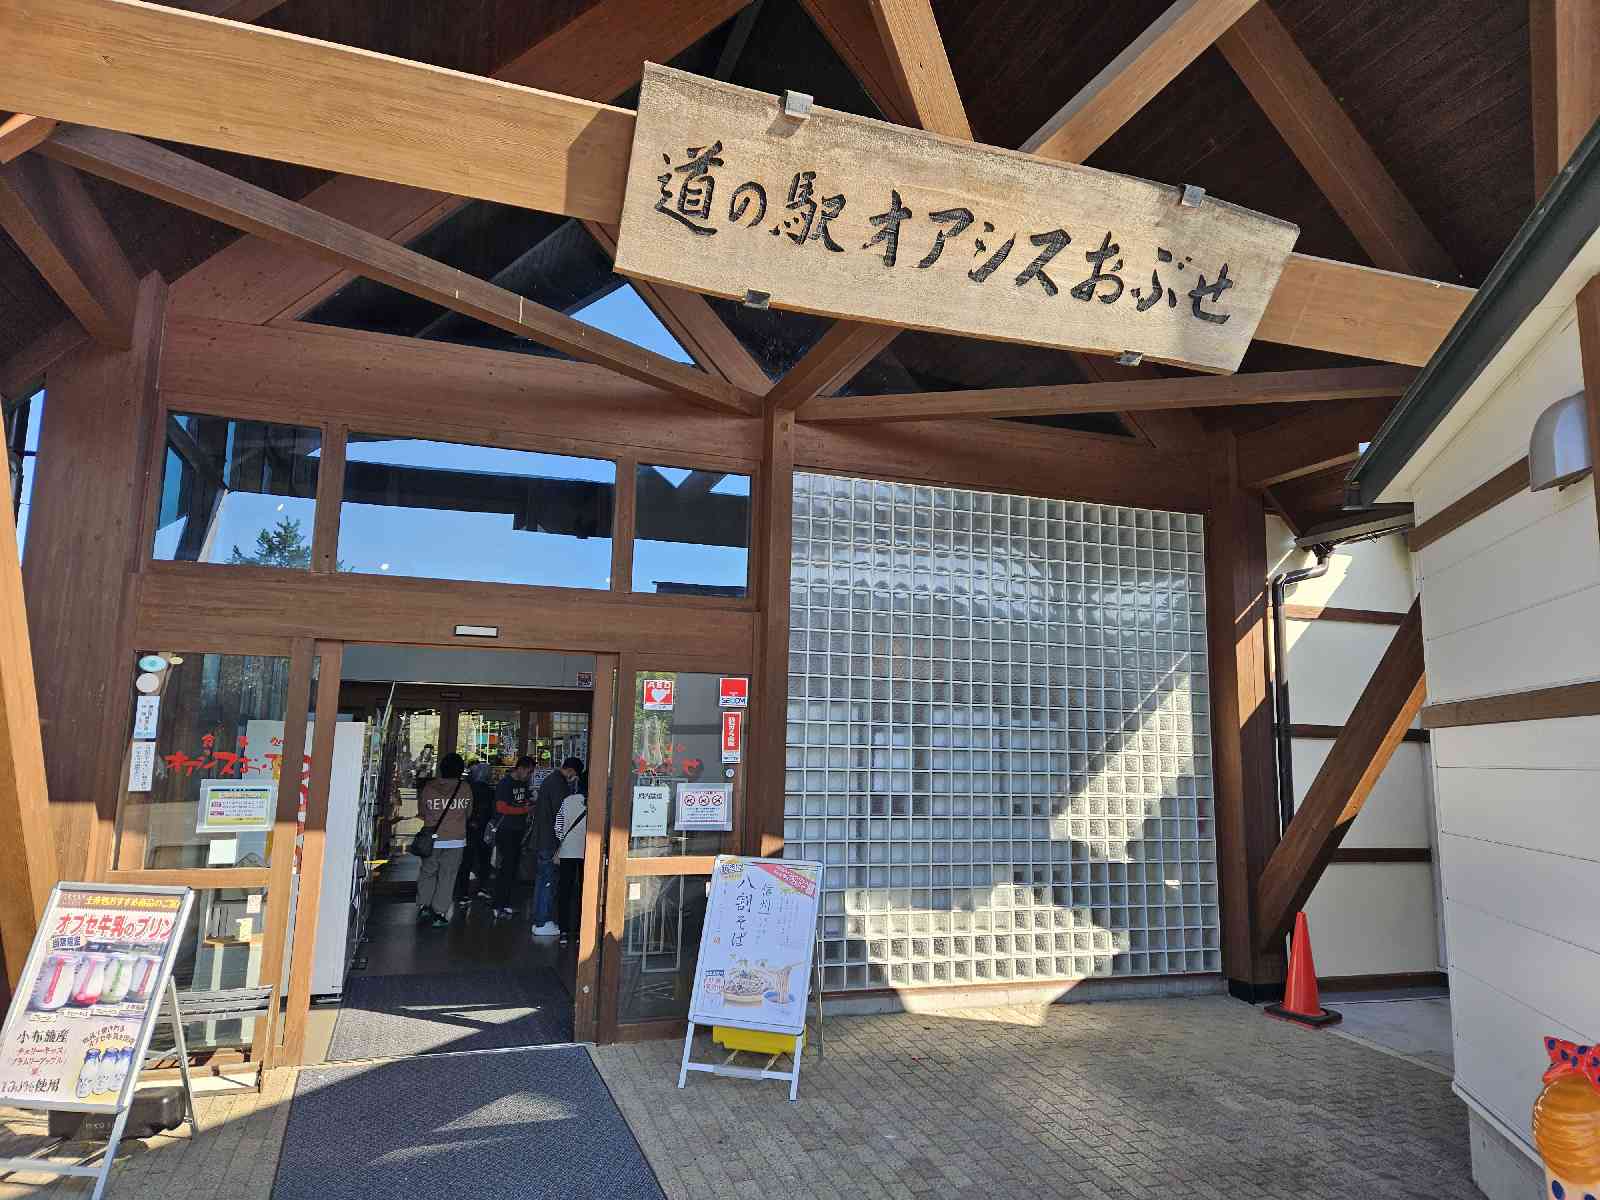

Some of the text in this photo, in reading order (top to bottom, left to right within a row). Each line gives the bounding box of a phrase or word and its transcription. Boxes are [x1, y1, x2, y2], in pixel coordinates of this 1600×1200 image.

[655, 139, 1236, 325] 道の駅オアシスおぶせ
[647, 680, 672, 689] AED
[729, 874, 757, 947] 八割そば
